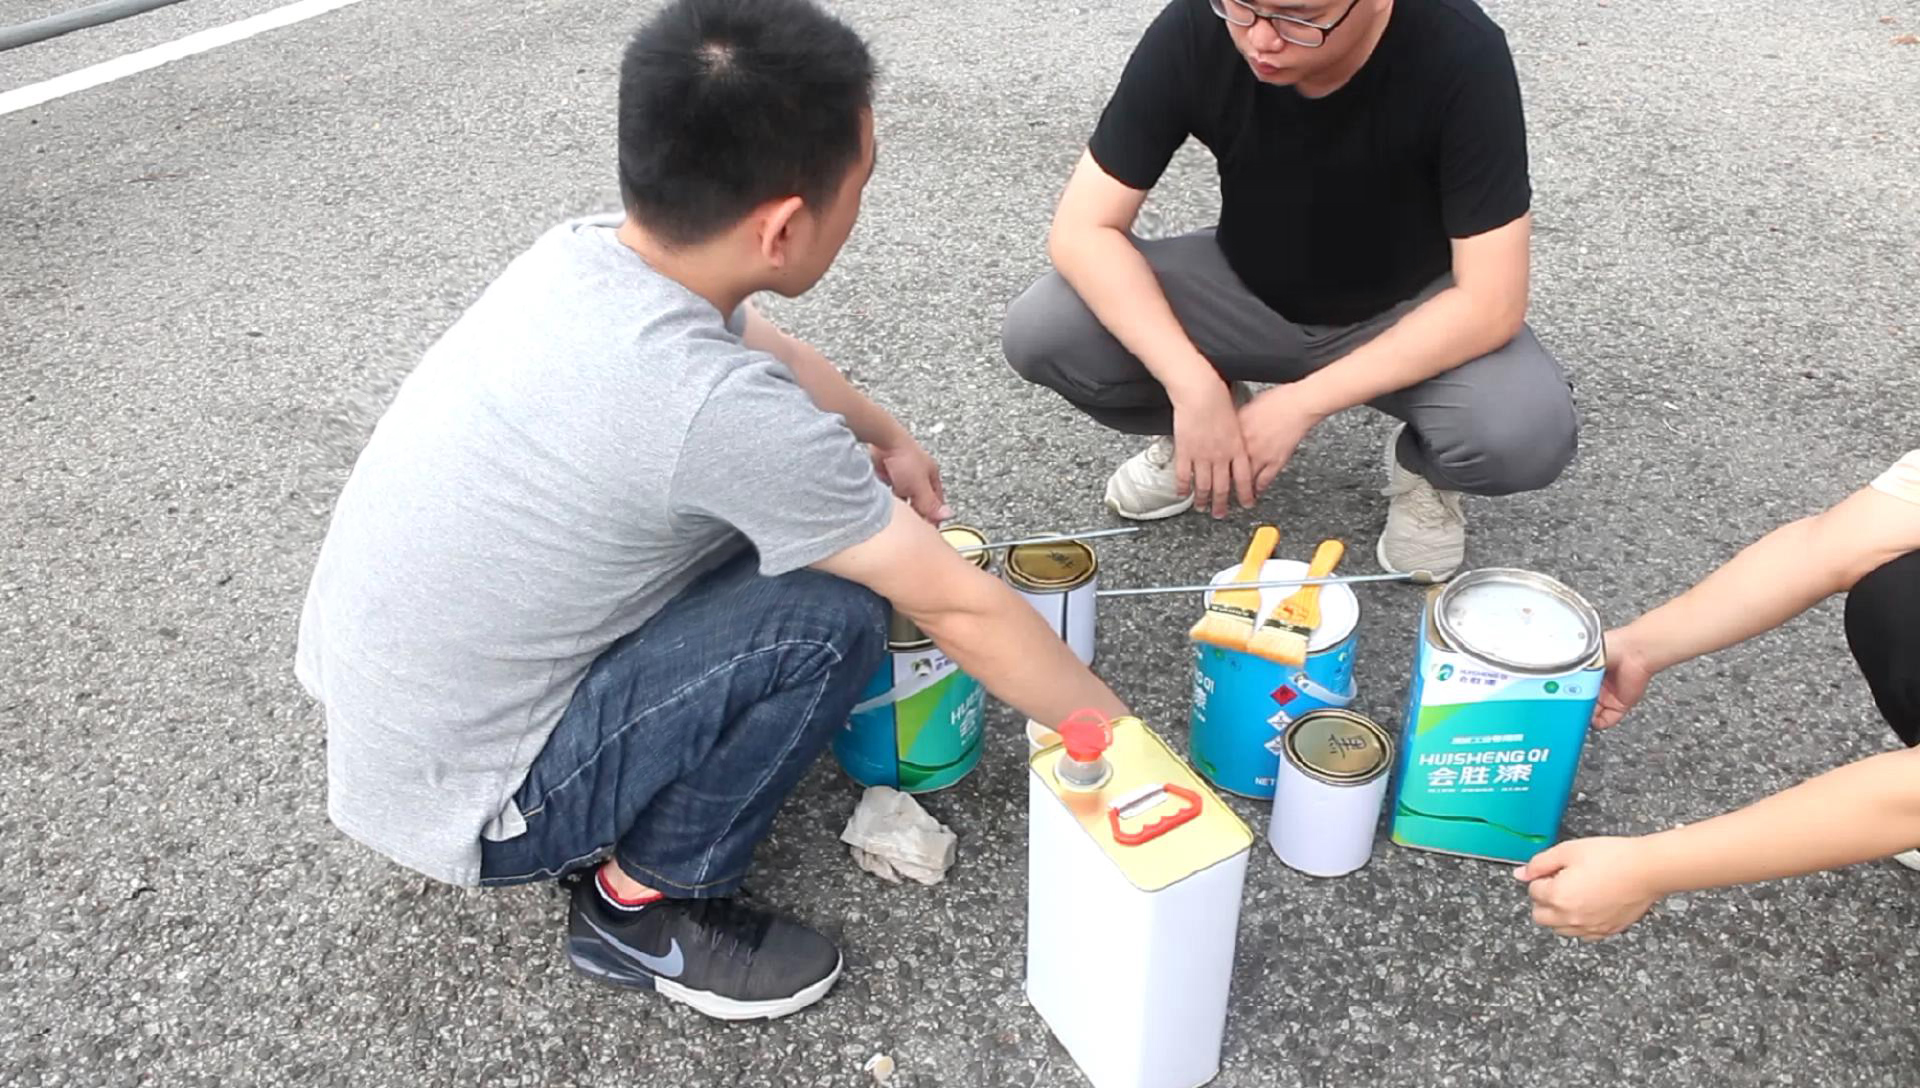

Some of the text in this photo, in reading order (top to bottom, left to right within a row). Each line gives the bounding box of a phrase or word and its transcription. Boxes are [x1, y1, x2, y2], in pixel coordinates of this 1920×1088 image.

[1419, 748, 1550, 766] HUISHENG QI
[1255, 776, 1275, 786] NET
[1427, 763, 1534, 786] 会胜漆
